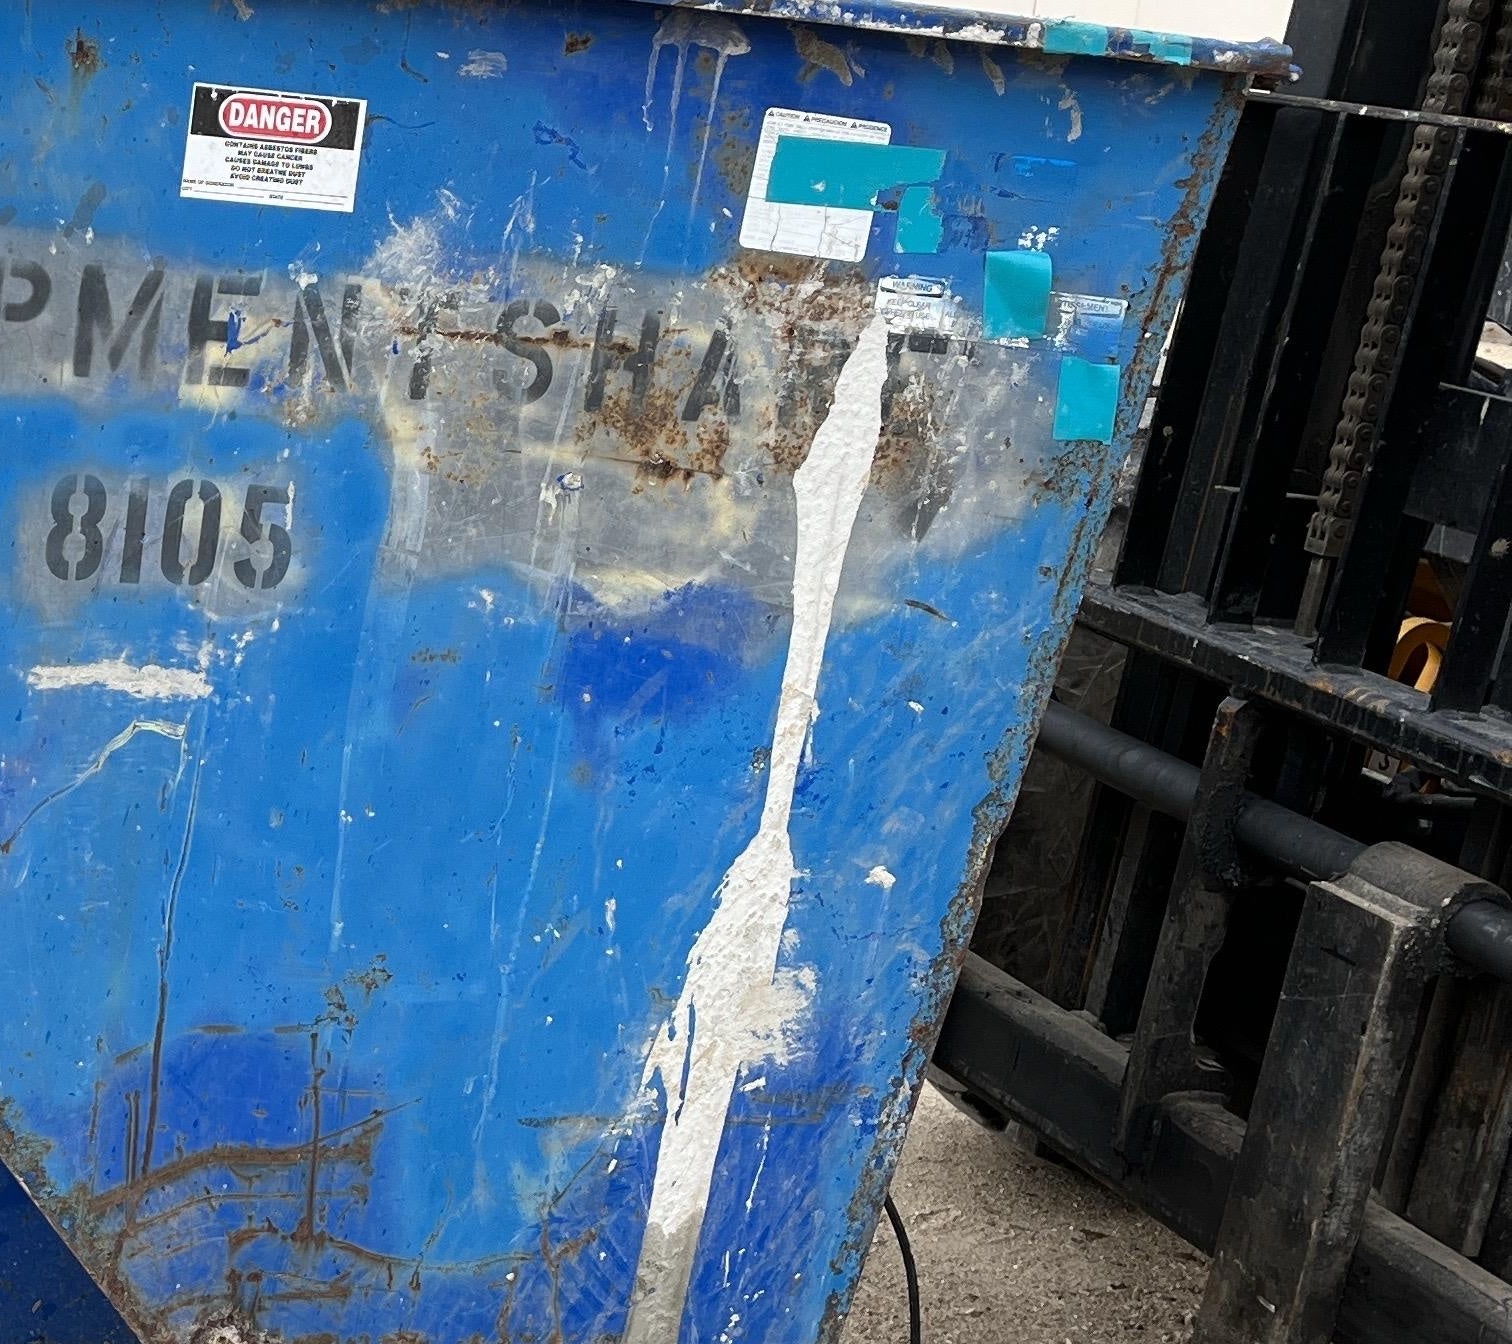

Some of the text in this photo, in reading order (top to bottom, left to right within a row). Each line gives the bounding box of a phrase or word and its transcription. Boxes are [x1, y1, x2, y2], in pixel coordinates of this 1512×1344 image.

[228, 101, 321, 135] DANGER
[224, 141, 318, 155] CONTAINS ASBESTOS FIBERS
[224, 157, 251, 165] CAUSES
[252, 159, 280, 167] DAMAGE
[253, 151, 275, 159] CAUSE
[276, 153, 303, 161] CANCER
[288, 170, 306, 178] DUST
[45, 473, 292, 590] 8105
